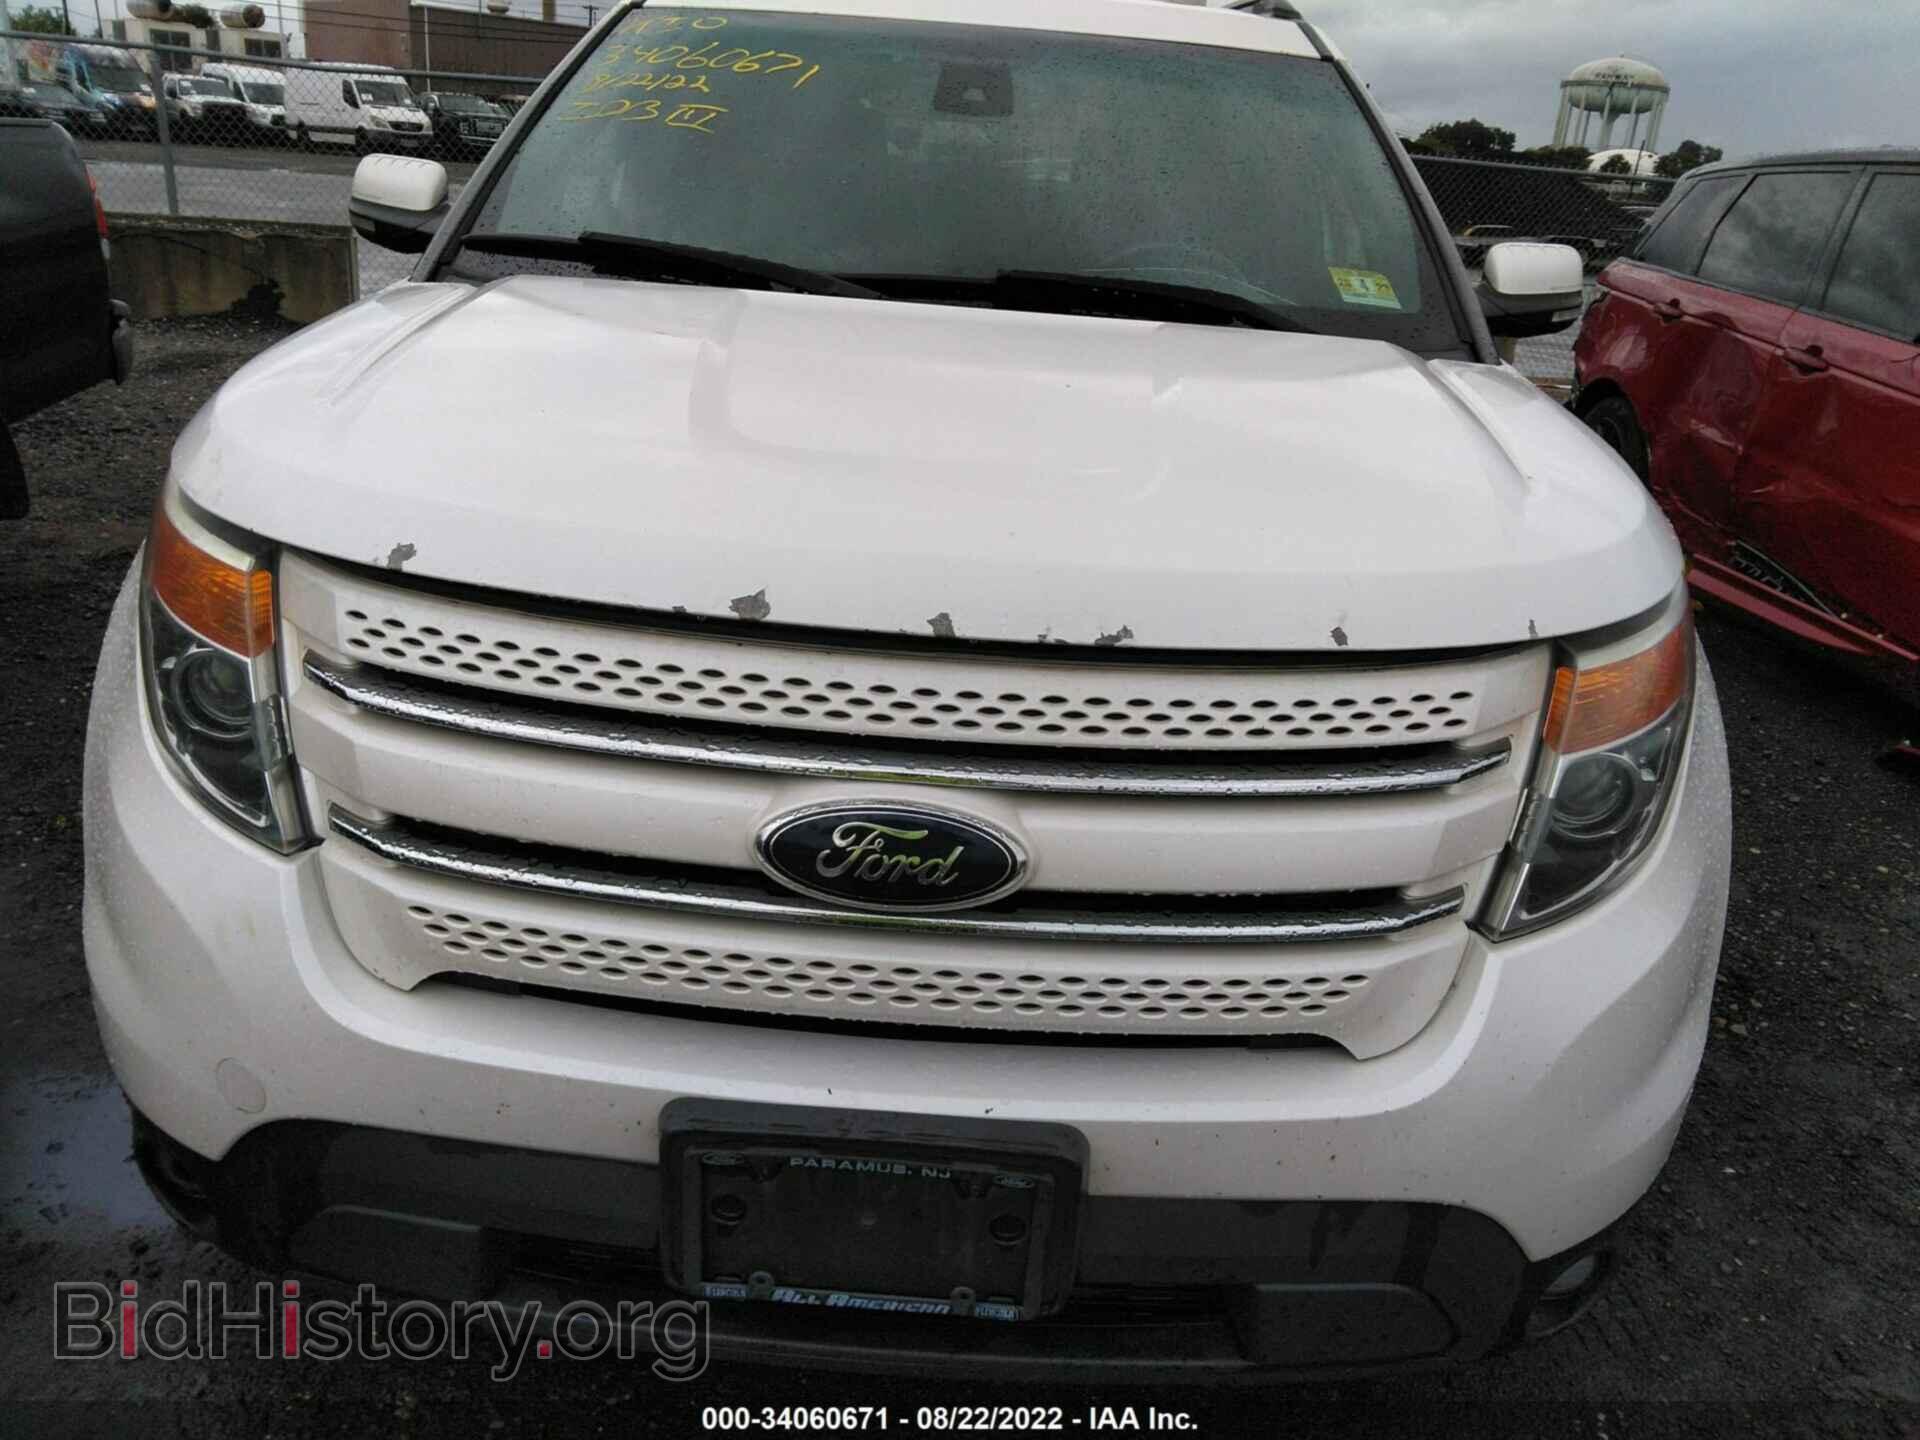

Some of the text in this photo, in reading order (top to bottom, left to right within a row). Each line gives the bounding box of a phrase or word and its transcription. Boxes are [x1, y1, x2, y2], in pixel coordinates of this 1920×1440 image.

[598, 41, 820, 89] 34060671
[816, 821, 965, 886] Ford
[921, 1166, 951, 1179] NJ
